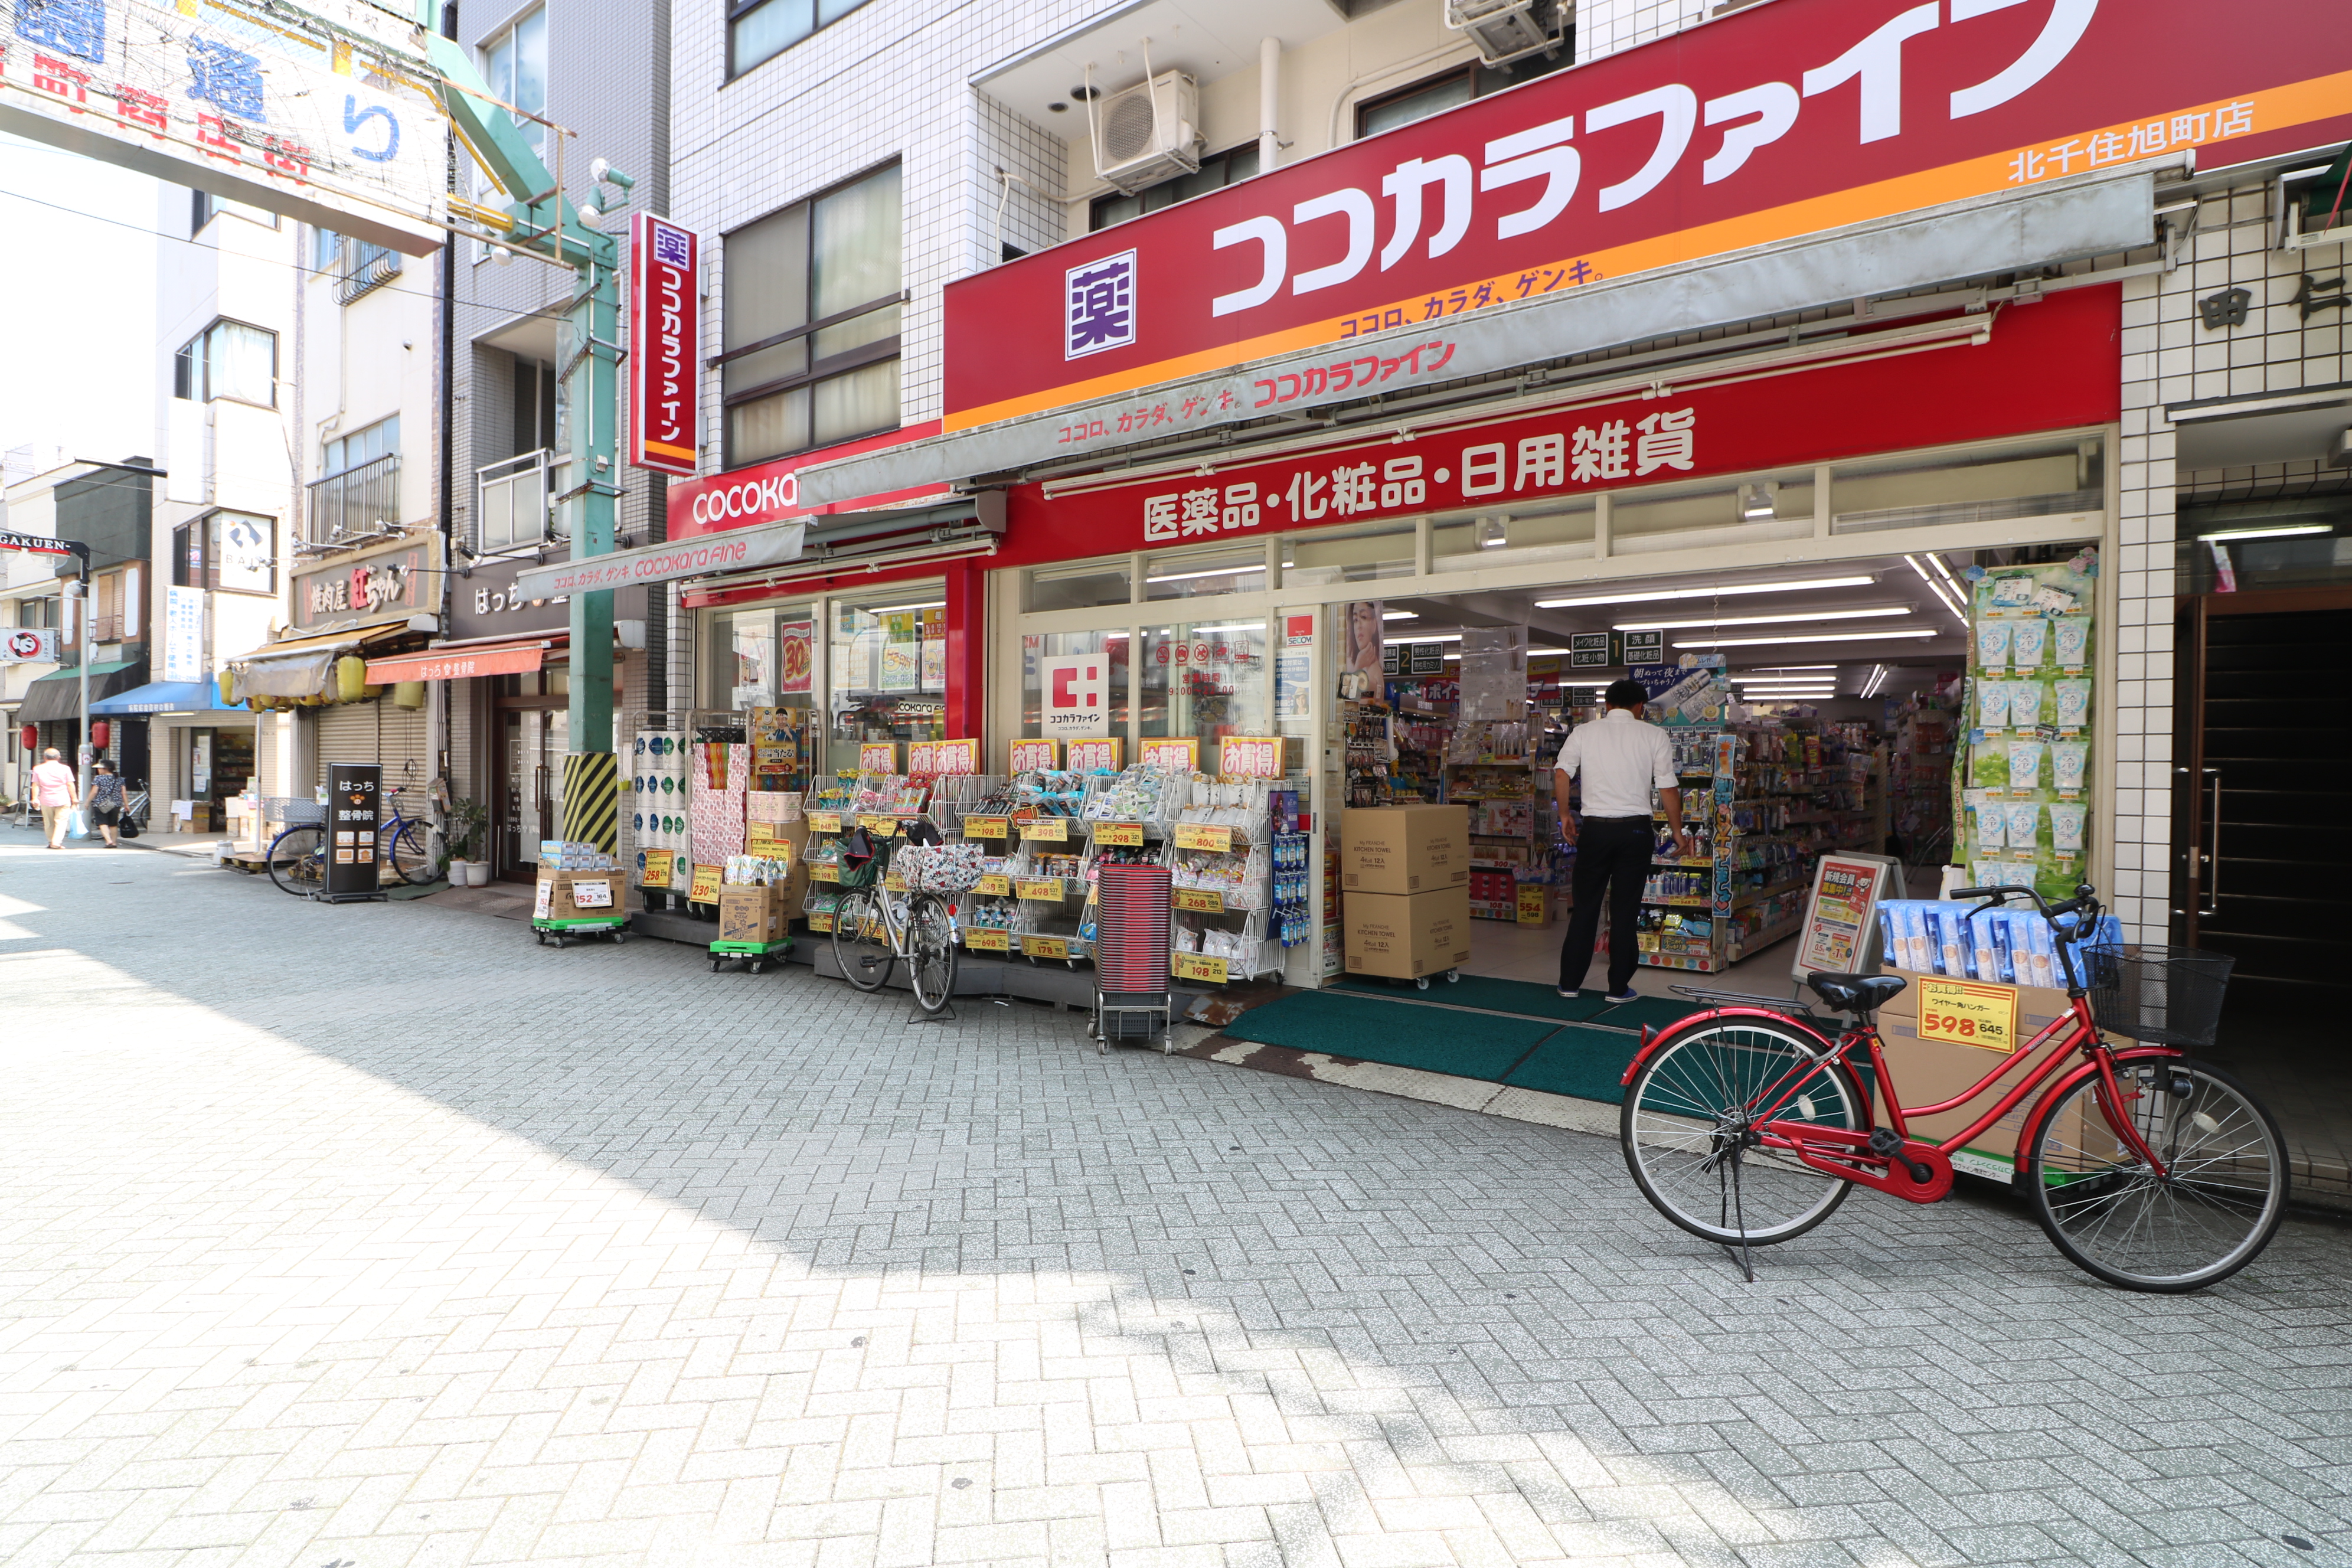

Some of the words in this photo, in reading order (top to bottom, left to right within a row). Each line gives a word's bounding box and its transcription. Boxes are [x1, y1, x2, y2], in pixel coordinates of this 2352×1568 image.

[2008, 102, 2255, 184] 北千住旭町店
[1213, 0, 2102, 318] ココカラファイン
[658, 228, 686, 266] 薬
[1340, 260, 1604, 339] ココロ、カラダ、ゲンキ。
[1072, 262, 1130, 350] 薬
[661, 266, 681, 441] ココカラファイン
[1058, 389, 1243, 444] ココロ、カラダ、ゲンキ。
[1254, 340, 1455, 409] ココカラファイン
[1144, 407, 1696, 543] 医薬品・化粧品・日用雑貨
[554, 565, 632, 590] ココロ、カラダ、ゲンキ。
[311, 580, 348, 614] 焼肉屋
[1288, 636, 1312, 645] SECOM
[1574, 636, 1605, 648] メイク化粧品
[1987, 635, 2000, 647] 冷
[2063, 633, 2076, 645] 冷
[1414, 646, 1440, 656] 男性化粧品
[1613, 640, 1619, 658] 1
[1401, 651, 1410, 668] 2
[1574, 653, 1605, 664] 化粧小物
[1628, 650, 1660, 661] 基礎化粧品
[421, 664, 441, 678] はっち
[453, 661, 475, 677] 整骨院
[1414, 660, 1440, 670] 男性用カミソリ
[1182, 672, 1220, 684] 営業時間
[1634, 667, 1687, 679] 朝ぬって夜まで
[1566, 690, 1571, 703] 5
[1988, 696, 2001, 707] 冷
[2065, 695, 2077, 707] 冷
[1050, 714, 1100, 724] ココカラファイン
[2017, 757, 2030, 768] 冷
[2062, 757, 2075, 769] 冷
[338, 780, 375, 793] はっち
[338, 809, 374, 822] 整骨院
[1984, 816, 1997, 828] 冷
[2060, 819, 2073, 830] 冷
[1037, 828, 1054, 837] 398
[1113, 834, 1129, 843] 298
[1196, 838, 1215, 848] 800
[645, 870, 660, 881] 258
[1824, 870, 1856, 886] 新規会員
[693, 884, 710, 896] 230
[982, 883, 996, 891] 198
[1031, 887, 1048, 896] 498
[576, 894, 593, 903] 152
[1187, 898, 1207, 908] 268
[1519, 903, 1540, 912] 554
[1037, 946, 1053, 954] 178
[1192, 966, 1210, 977] 198
[1927, 983, 1964, 995] お買得!!
[1932, 998, 1991, 1011] ワイヤー角ハンガー
[1925, 1012, 1975, 1037] 598
[1979, 1023, 2003, 1035] 645
